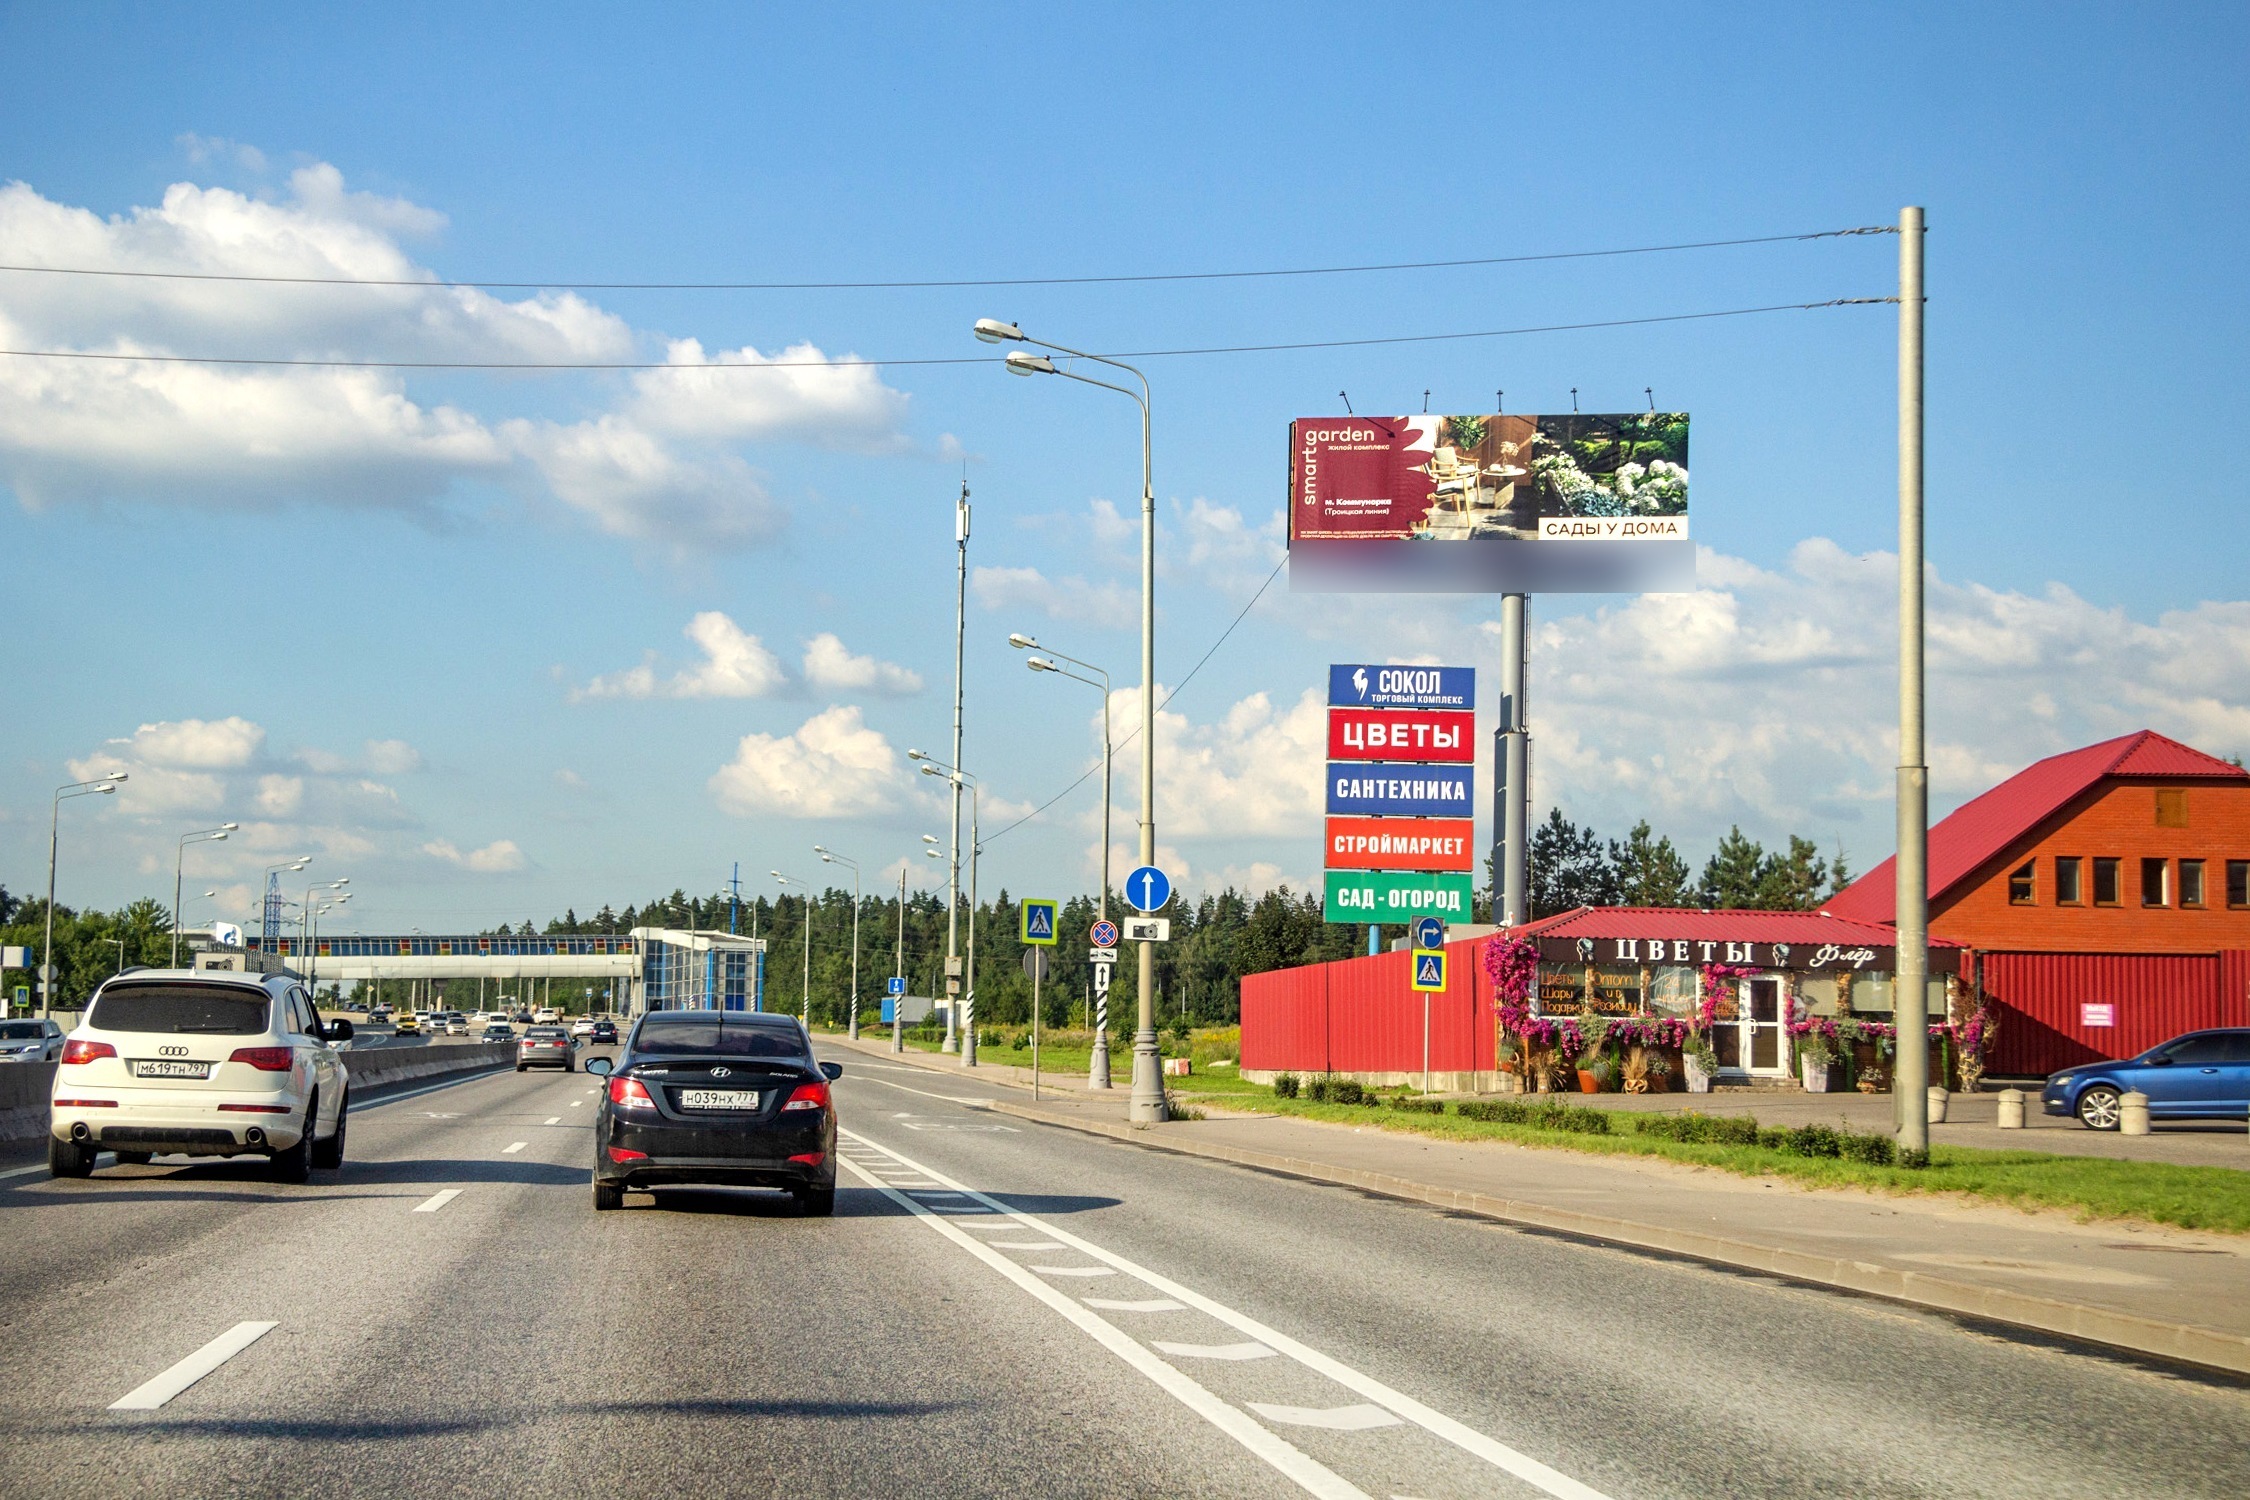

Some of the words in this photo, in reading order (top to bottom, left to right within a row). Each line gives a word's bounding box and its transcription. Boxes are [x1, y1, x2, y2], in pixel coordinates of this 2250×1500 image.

[1305, 426, 1375, 446] garden
[1327, 443, 1352, 451] жилой
[1301, 447, 1317, 505] smart
[1336, 498, 1392, 507] Коммунарка
[1324, 507, 1363, 516] (Троицкая
[1546, 523, 1600, 536] САДЫ
[1606, 523, 1618, 535] У
[1622, 522, 1678, 536] ДОМА
[1379, 670, 1441, 694] СОКОЛ
[1371, 694, 1413, 703] ТОРГОВЫЙ
[1417, 696, 1464, 704] КОМПЛЕКС
[1343, 722, 1460, 750] ЦВЕТЫ
[1336, 778, 1466, 800] САНТЕХНИКА
[1334, 834, 1464, 855] СТРОЙМАРКЕТ
[1338, 888, 1375, 910] САД
[1388, 889, 1461, 911] ОГОРОД
[1615, 939, 1754, 963] ЦВЕТЫ
[1541, 971, 1575, 986] Цветы
[1593, 972, 1633, 986] Оптом
[1664, 976, 1680, 989] 24
[1541, 987, 1574, 1000] Шары
[1541, 1001, 1585, 1014] Подарки
[736, 1092, 755, 1102] 777
